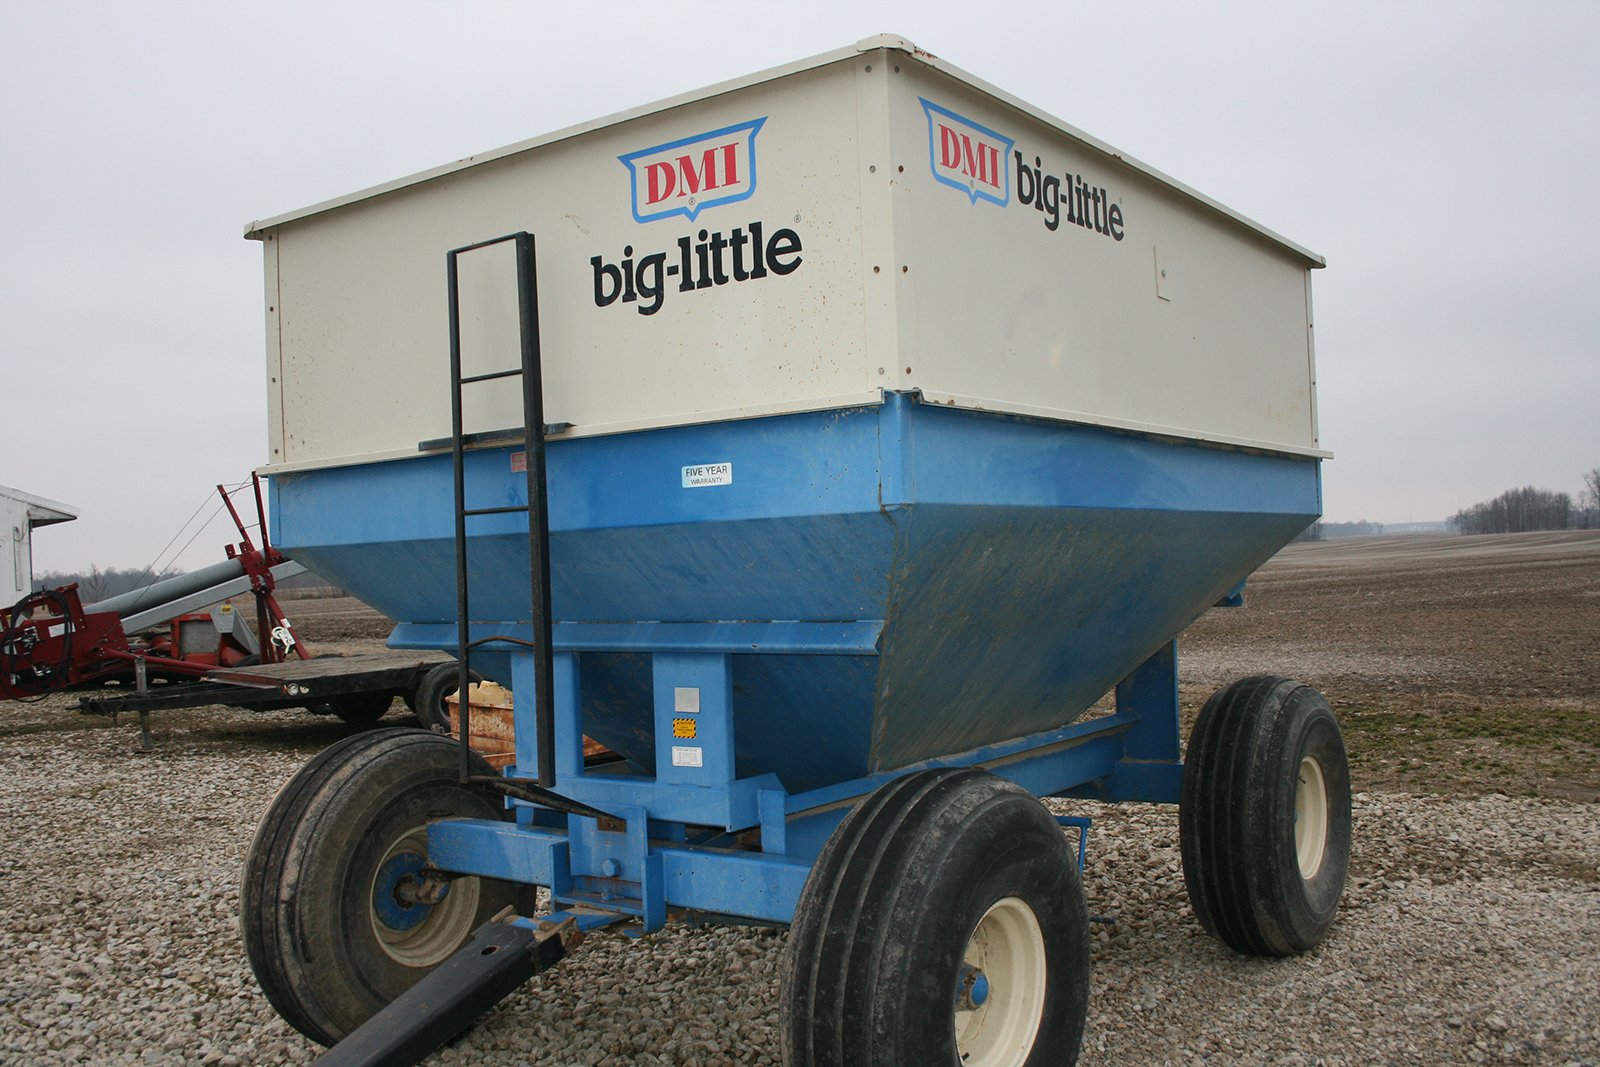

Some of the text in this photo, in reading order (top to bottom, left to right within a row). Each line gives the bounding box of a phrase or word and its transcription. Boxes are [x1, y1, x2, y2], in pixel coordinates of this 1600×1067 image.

[644, 142, 741, 206] DMI
[938, 123, 1001, 189] DMI
[1014, 149, 1125, 242] big-little
[590, 221, 803, 317] big-little
[685, 465, 728, 477] FIVE YEAR
[690, 477, 723, 485] WARRANTY
